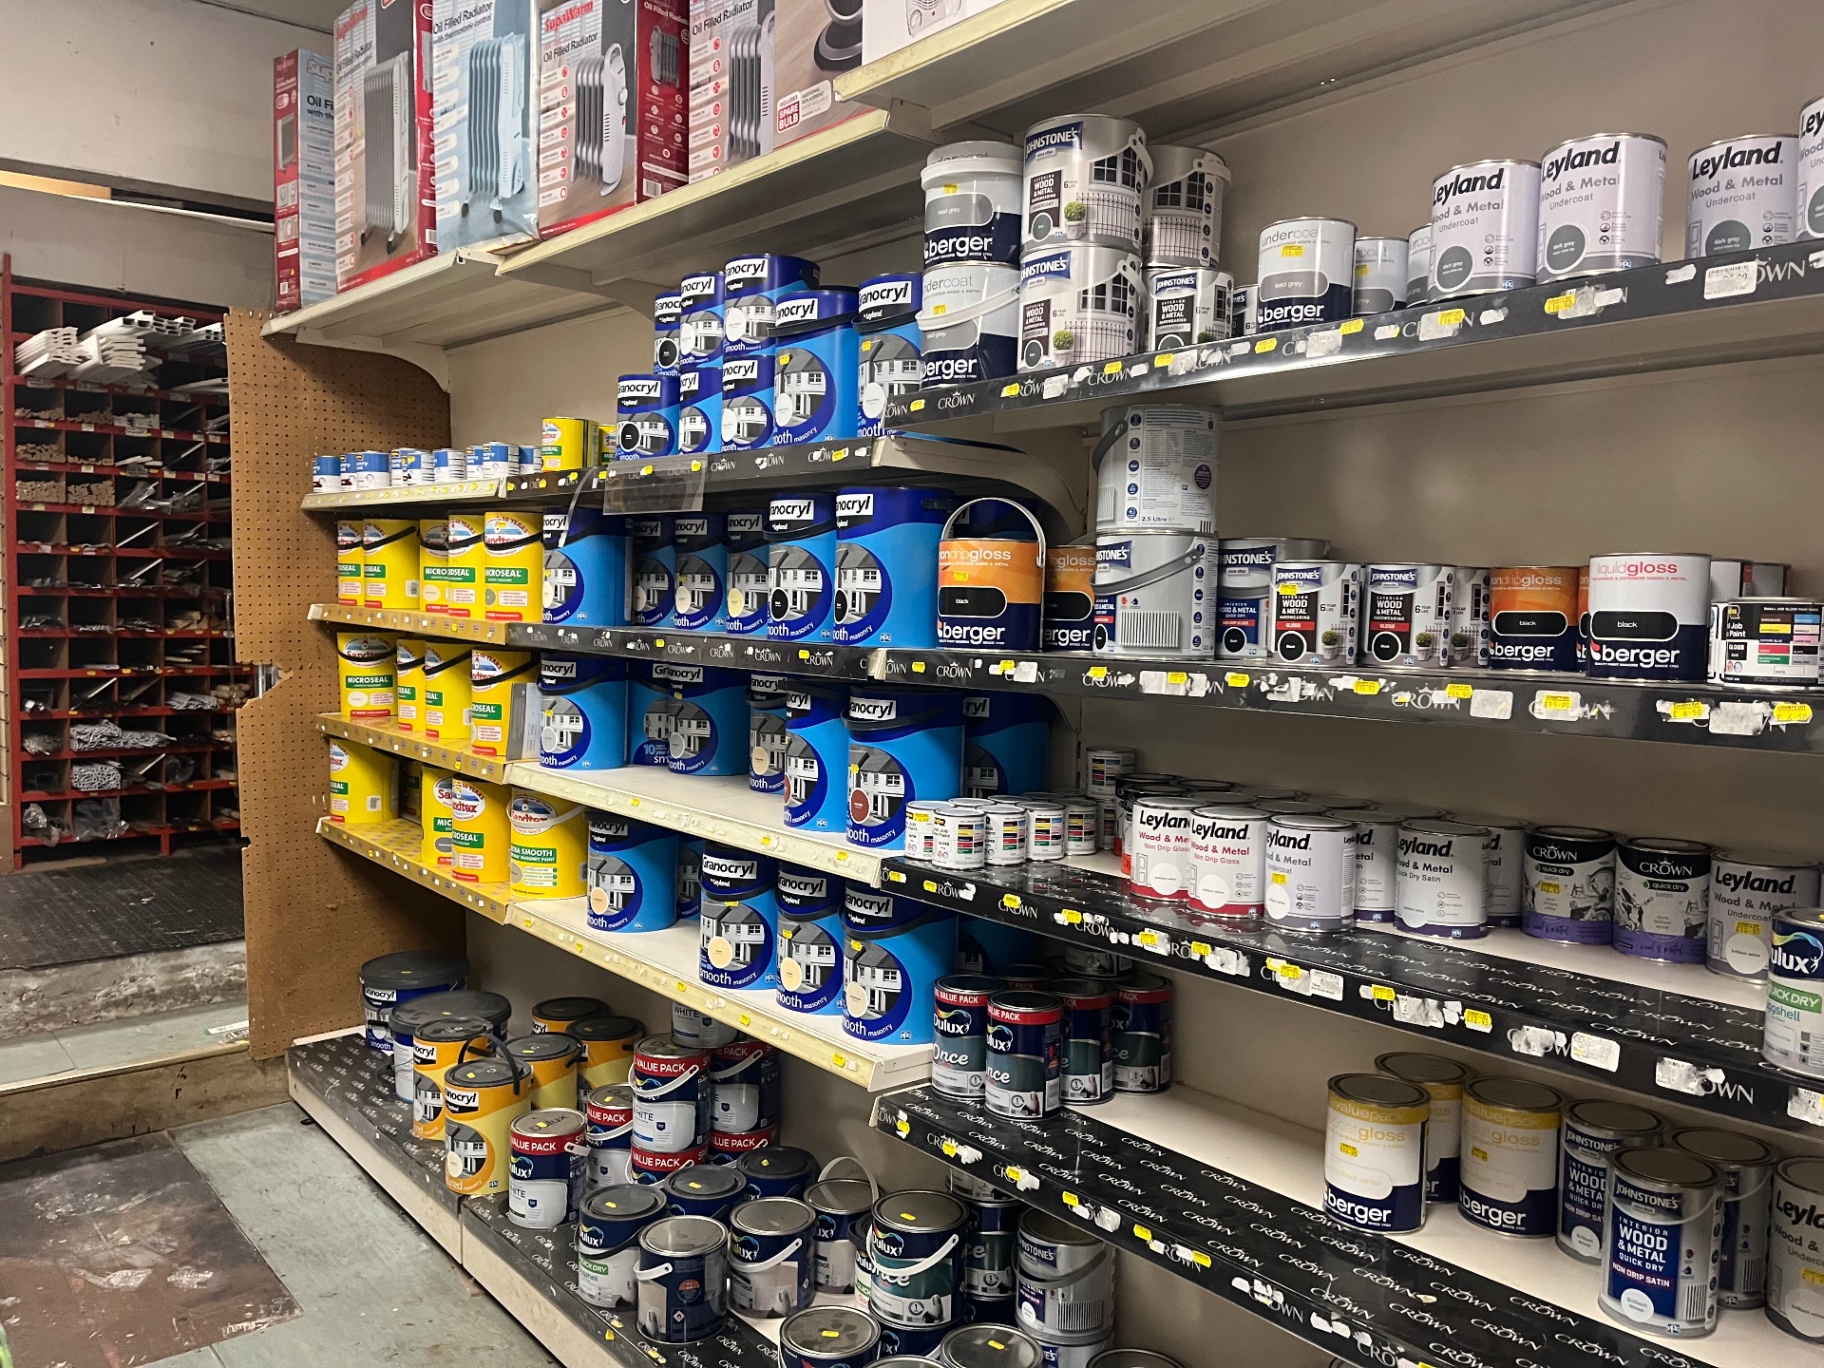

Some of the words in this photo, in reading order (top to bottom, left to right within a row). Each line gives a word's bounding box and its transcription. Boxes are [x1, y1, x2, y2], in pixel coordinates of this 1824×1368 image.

[433, 22, 443, 34] Oil
[444, 14, 462, 30] Filled
[463, 1, 493, 22] Radiator
[544, 2, 593, 32] SupaWarm
[654, 4, 668, 17] Filled
[692, 24, 703, 36] Oil
[704, 15, 722, 33] Filled
[544, 51, 553, 63] Oil
[553, 43, 570, 60] Filled
[571, 32, 598, 52] Radiator
[307, 95, 322, 108] Oil
[780, 103, 798, 118] SPARE
[779, 113, 798, 129] BULB
[1026, 127, 1077, 159] JOHNSTONE'S
[1542, 141, 1620, 184] Leyland
[1692, 141, 1783, 180] Leyland
[1034, 178, 1054, 190] WOOD
[1565, 181, 1575, 191] &
[1580, 174, 1621, 188] Metal
[1691, 182, 1721, 201] Wood
[1725, 179, 1736, 190] &
[1741, 174, 1783, 187] Metal
[1550, 193, 1593, 211] Undercoat
[1706, 192, 1756, 209] Undercoat
[1439, 216, 1479, 233] Undercoat
[929, 236, 993, 257] berger
[1714, 237, 1727, 245] dark
[1728, 235, 1740, 244] grey
[1157, 276, 1195, 291] JOHNSTONE'S
[1288, 280, 1303, 289] grey
[1026, 307, 1043, 317] WOOD
[1052, 309, 1057, 317] 6
[1162, 304, 1184, 312] WOOD
[1264, 304, 1324, 322] berger
[937, 394, 975, 410] CROWN
[794, 426, 818, 443] masonry
[1277, 570, 1320, 582] JOHNSTONE'S
[1372, 572, 1415, 583] JOHNSTONE'S
[1597, 562, 1677, 576] liquidgloss
[1282, 600, 1307, 608] WOOD
[790, 622, 813, 636] masonry
[850, 625, 873, 640] masonry
[943, 622, 1005, 644] berger
[1495, 642, 1554, 661] berger
[1602, 645, 1680, 668] berger
[936, 663, 973, 679] CROWN
[347, 676, 388, 684] MICROSEAL
[871, 829, 896, 844] masonry
[1139, 831, 1161, 842] Wood
[1164, 834, 1171, 842] &
[1192, 819, 1249, 840] Leyland
[1191, 842, 1208, 852] Wood
[1211, 845, 1218, 853] &
[1222, 846, 1250, 856] Metal
[1532, 846, 1577, 861] CROWN
[1205, 855, 1218, 863] Drip
[1220, 857, 1240, 865] Gloss
[1276, 854, 1280, 862] &
[1284, 857, 1311, 866] Metal
[1639, 860, 1692, 876] CROWN
[1409, 873, 1419, 881] Dry
[1542, 865, 1558, 874] quick
[1559, 868, 1569, 876] dry
[1651, 882, 1671, 891] quick
[1672, 883, 1686, 892] dry
[1715, 866, 1793, 894] Leyland
[1772, 947, 1810, 974] ulux
[733, 972, 757, 986] masonry
[1488, 977, 1563, 996] CROWN
[803, 996, 827, 1010] masonry
[960, 995, 979, 1004] PACK
[674, 1006, 700, 1020] WHITE
[1629, 1009, 1715, 1030] CROWN
[868, 1024, 893, 1037] masonry
[934, 1014, 964, 1034] Dulux
[1590, 1023, 1678, 1046] CROWN
[933, 1044, 968, 1065] Once
[637, 1059, 658, 1072] VALUE
[660, 1064, 685, 1073] PACK
[608, 1111, 626, 1123] PACK
[532, 1141, 556, 1152] PACK
[731, 1138, 755, 1148] PACK
[1065, 1128, 1108, 1148] CROWN
[1121, 1137, 1166, 1156] CROWN
[1024, 1140, 1066, 1160] CROWN
[633, 1153, 654, 1166] VALUE
[655, 1158, 680, 1167] PACK
[1081, 1149, 1126, 1170] CROWN
[1039, 1163, 1084, 1185] CROWN
[1140, 1159, 1187, 1181] CROWN
[1098, 1173, 1146, 1196] CROWN
[1201, 1169, 1250, 1192] CROWN
[1161, 1184, 1210, 1207] CROWN
[1569, 1194, 1589, 1208] QUICK
[1616, 1183, 1678, 1209] JOHNSTONE'S
[1327, 1193, 1392, 1224] berger
[1461, 1194, 1526, 1226] berger
[1619, 1216, 1668, 1236] INTERIOR
[1619, 1224, 1668, 1250] WOOD
[1618, 1240, 1625, 1250] &
[1626, 1242, 1666, 1263] METAL
[1619, 1252, 1643, 1268] QUICK
[1645, 1262, 1664, 1272] DRY
[1612, 1262, 1629, 1276] NON
[1626, 1268, 1644, 1280] DRIP
[1645, 1275, 1670, 1287] SATIN
[1430, 1282, 1496, 1312] CROWN
[1509, 1296, 1579, 1327] CROWN
[1470, 1318, 1542, 1351] CROWN
[1554, 1333, 1629, 1366] CROWN
